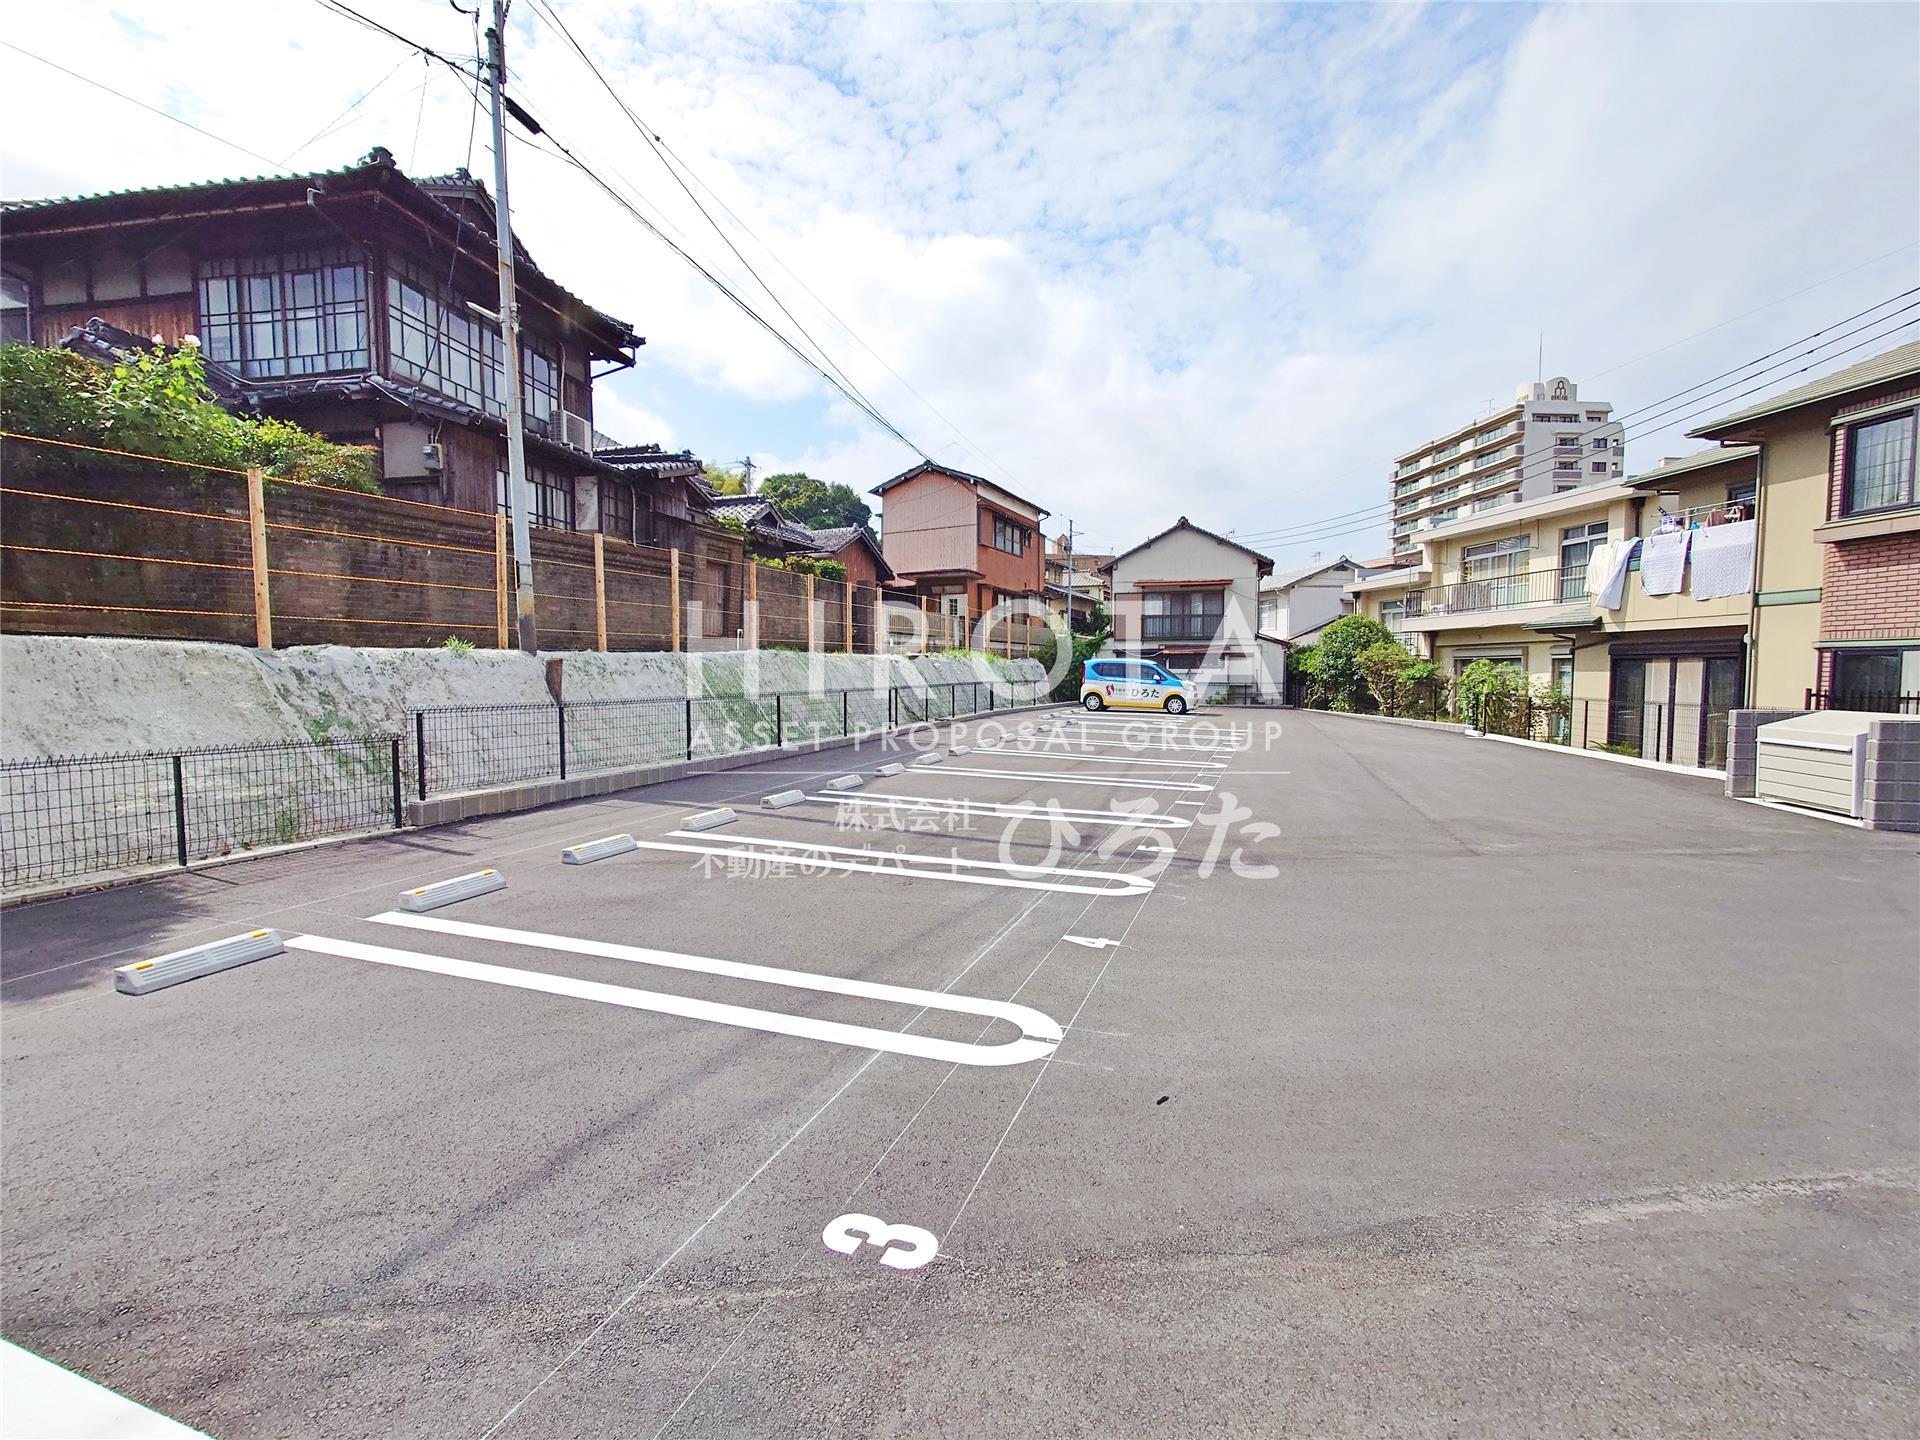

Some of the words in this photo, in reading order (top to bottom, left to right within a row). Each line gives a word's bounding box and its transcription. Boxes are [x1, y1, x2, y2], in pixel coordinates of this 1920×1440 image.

[1131, 688, 1160, 699] ひろた
[822, 1213, 939, 1269] 3
